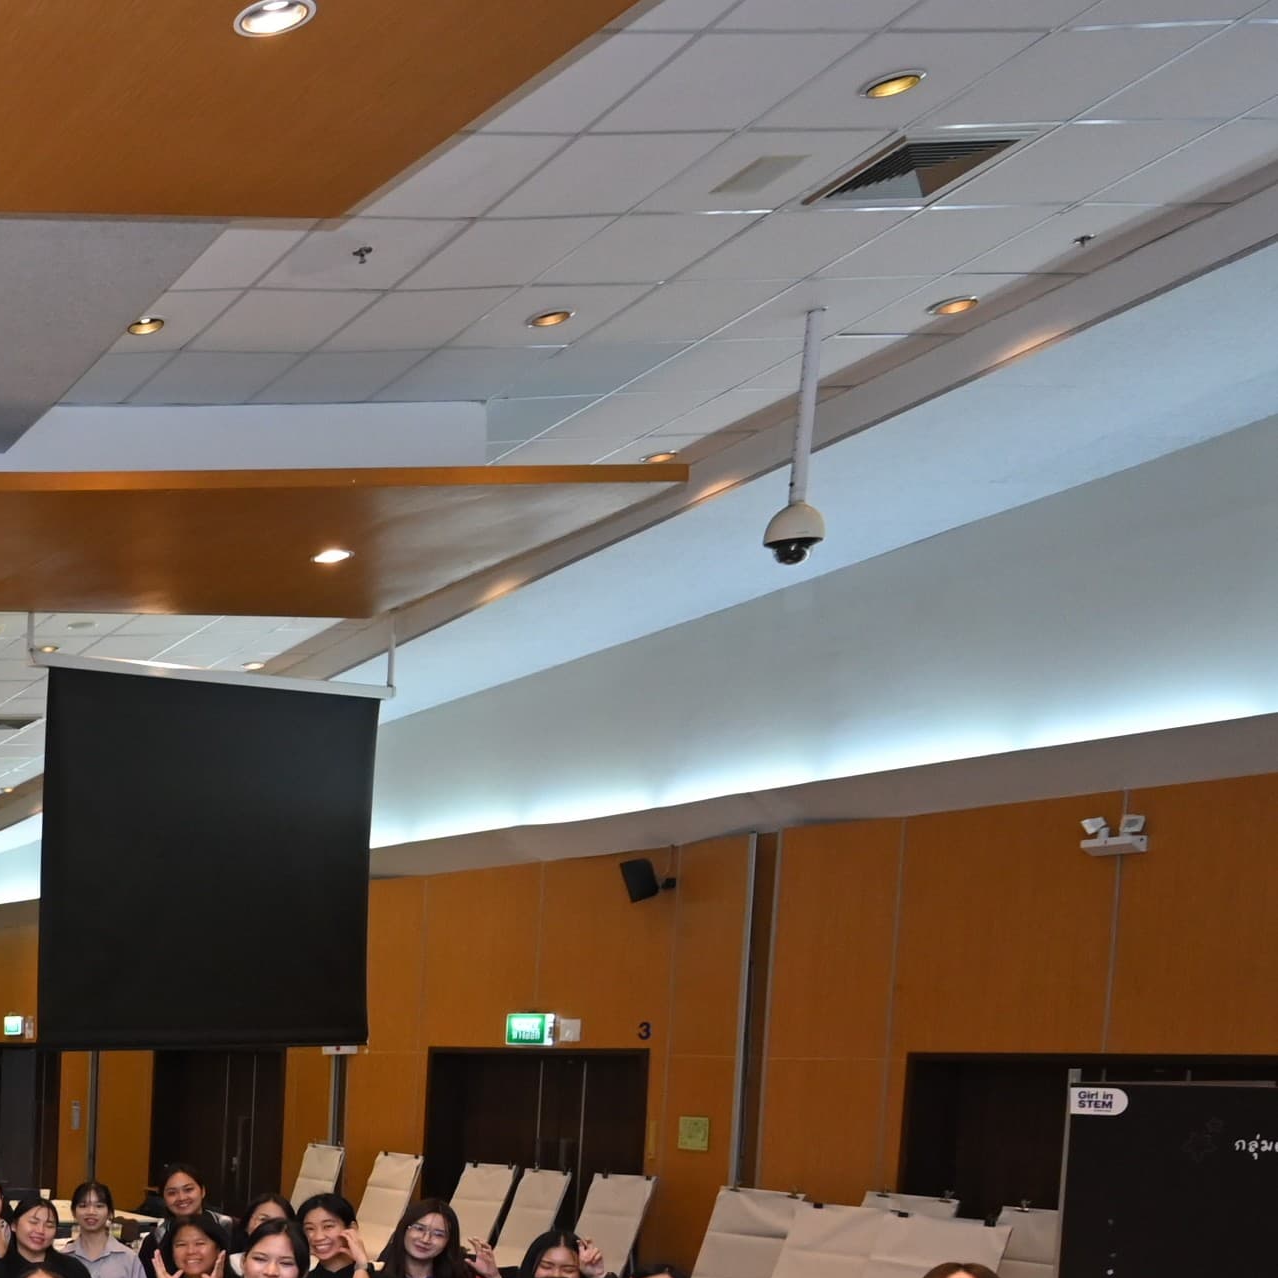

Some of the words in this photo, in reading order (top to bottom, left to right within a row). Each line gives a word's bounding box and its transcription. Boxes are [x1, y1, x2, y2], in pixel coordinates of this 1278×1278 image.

[638, 1022, 651, 1040] 3
[1078, 1090, 1099, 1100] Girl
[1103, 1091, 1113, 1100] in
[1078, 1100, 1113, 1109] STEM
